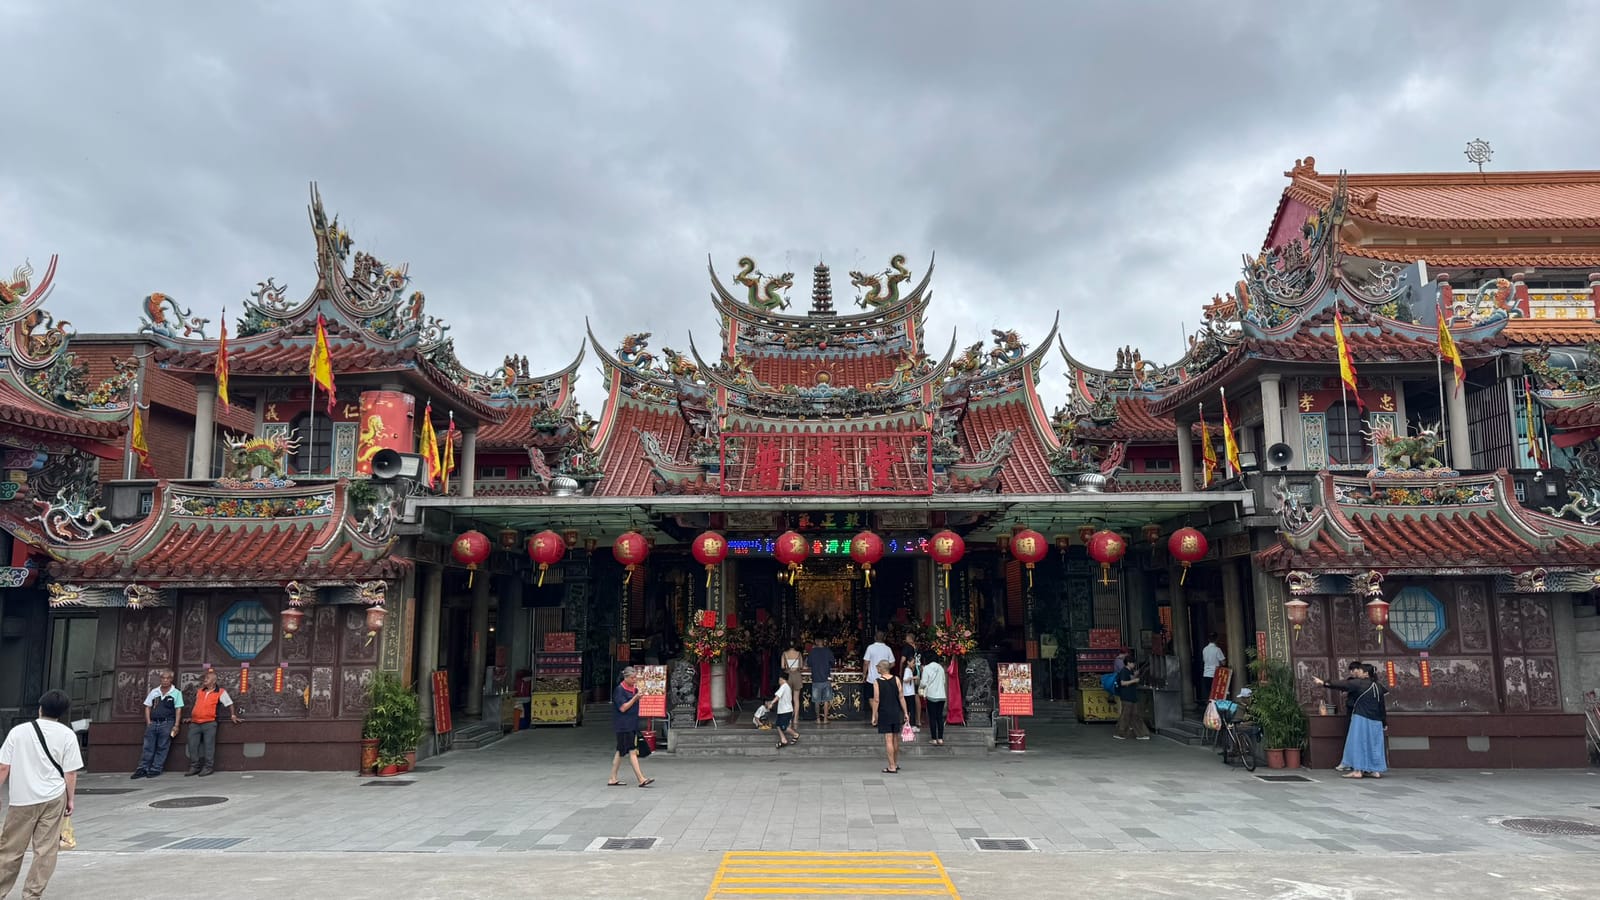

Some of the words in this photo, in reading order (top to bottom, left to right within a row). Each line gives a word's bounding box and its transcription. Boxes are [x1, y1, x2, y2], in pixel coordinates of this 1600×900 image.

[343, 403, 359, 419] 仁
[1299, 393, 1314, 411] 孝
[1380, 393, 1395, 411] 忠
[752, 439, 902, 488] 普濟堂
